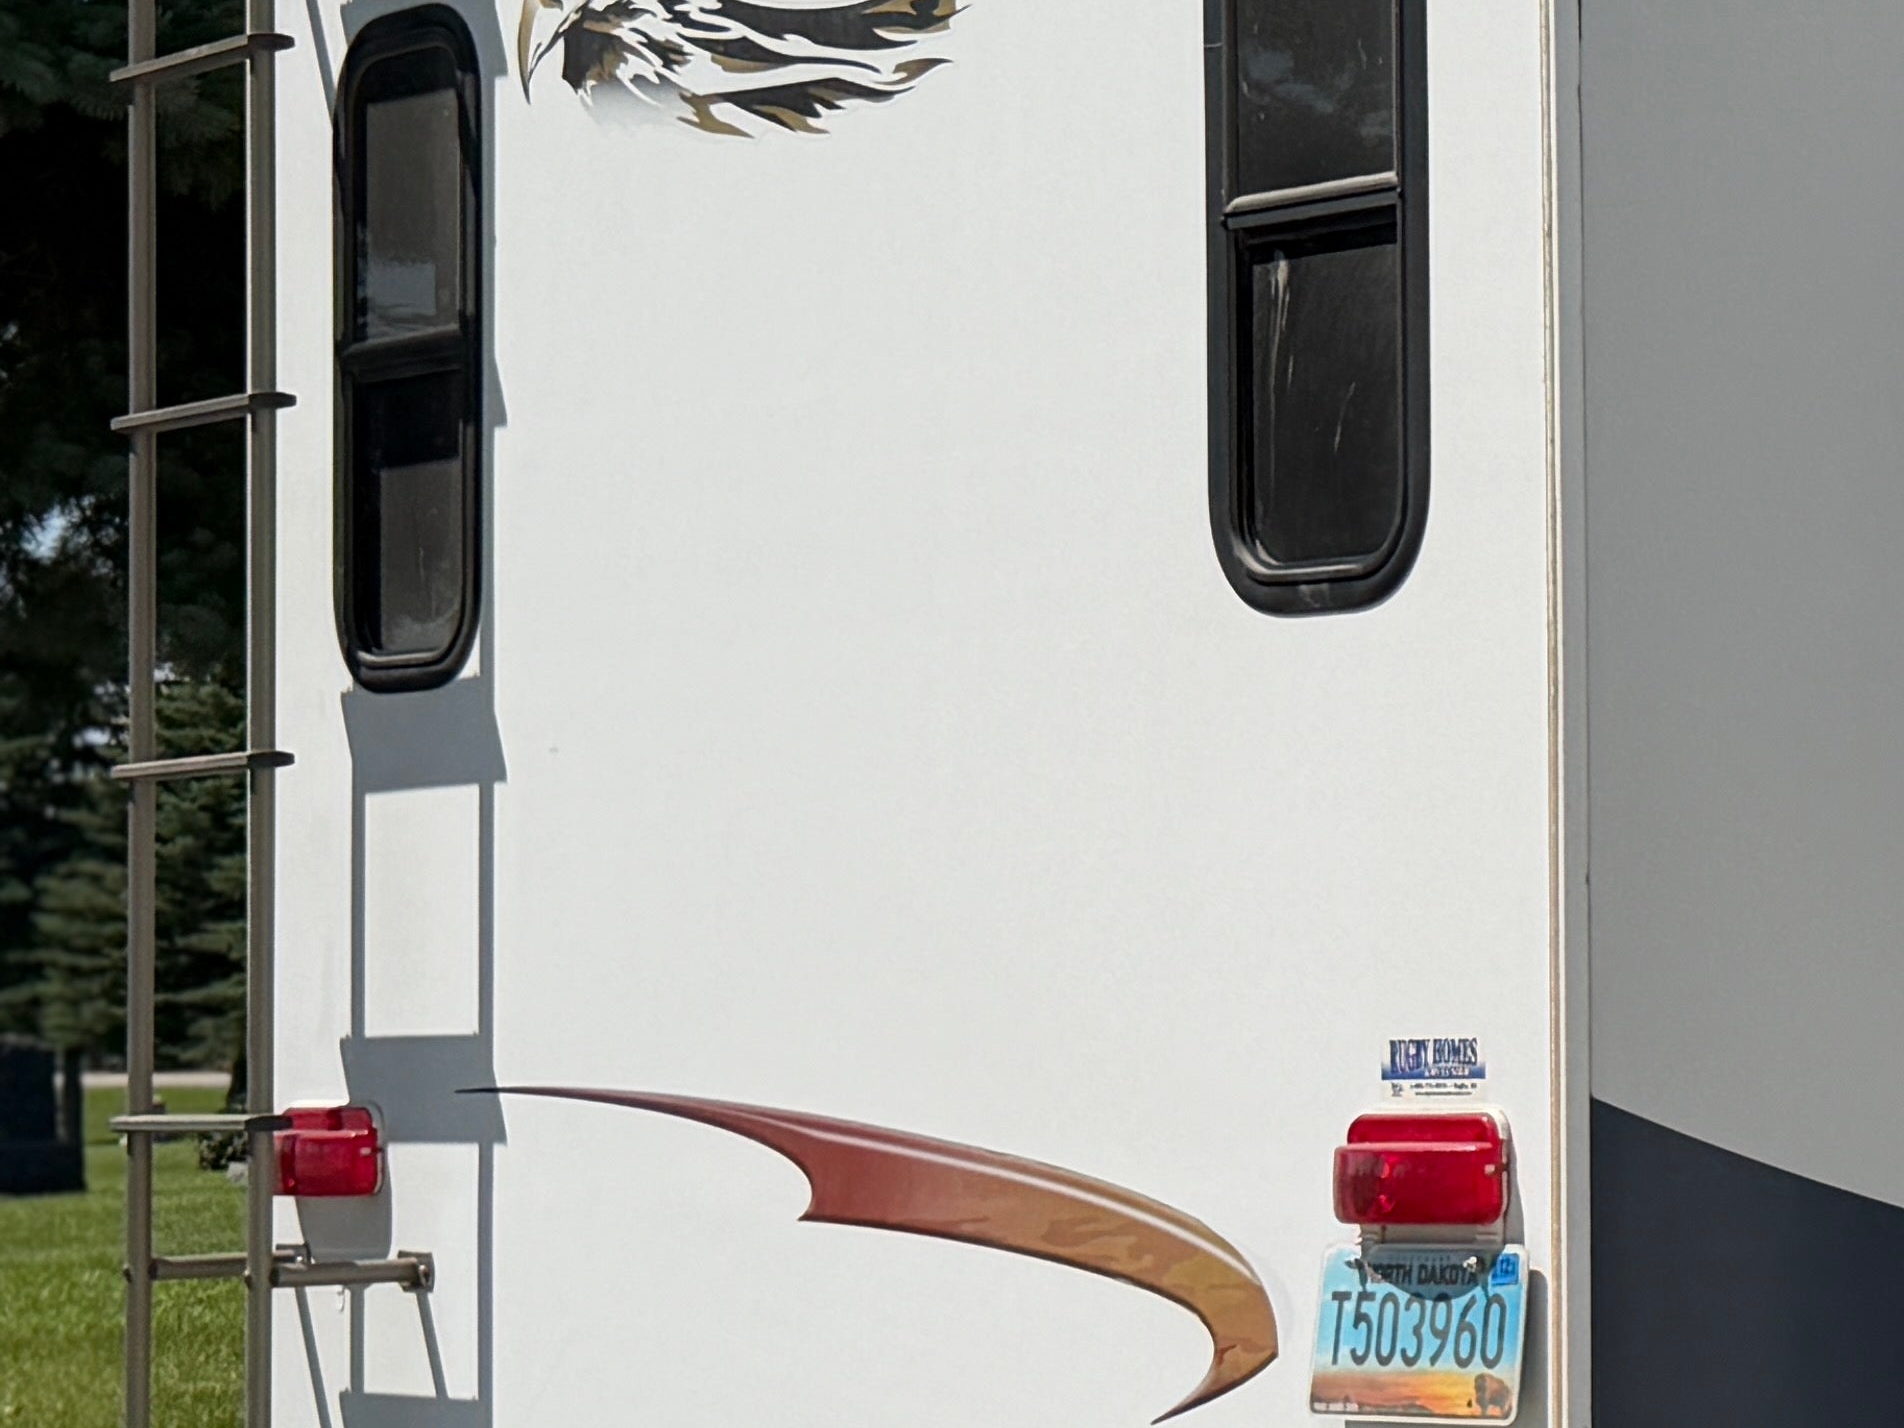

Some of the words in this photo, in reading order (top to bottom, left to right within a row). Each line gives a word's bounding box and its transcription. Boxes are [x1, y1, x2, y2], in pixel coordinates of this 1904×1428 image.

[1432, 1037, 1477, 1065] HOMES
[1418, 1262, 1480, 1286] DAKOTA
[1331, 1290, 1507, 1370] T503960
